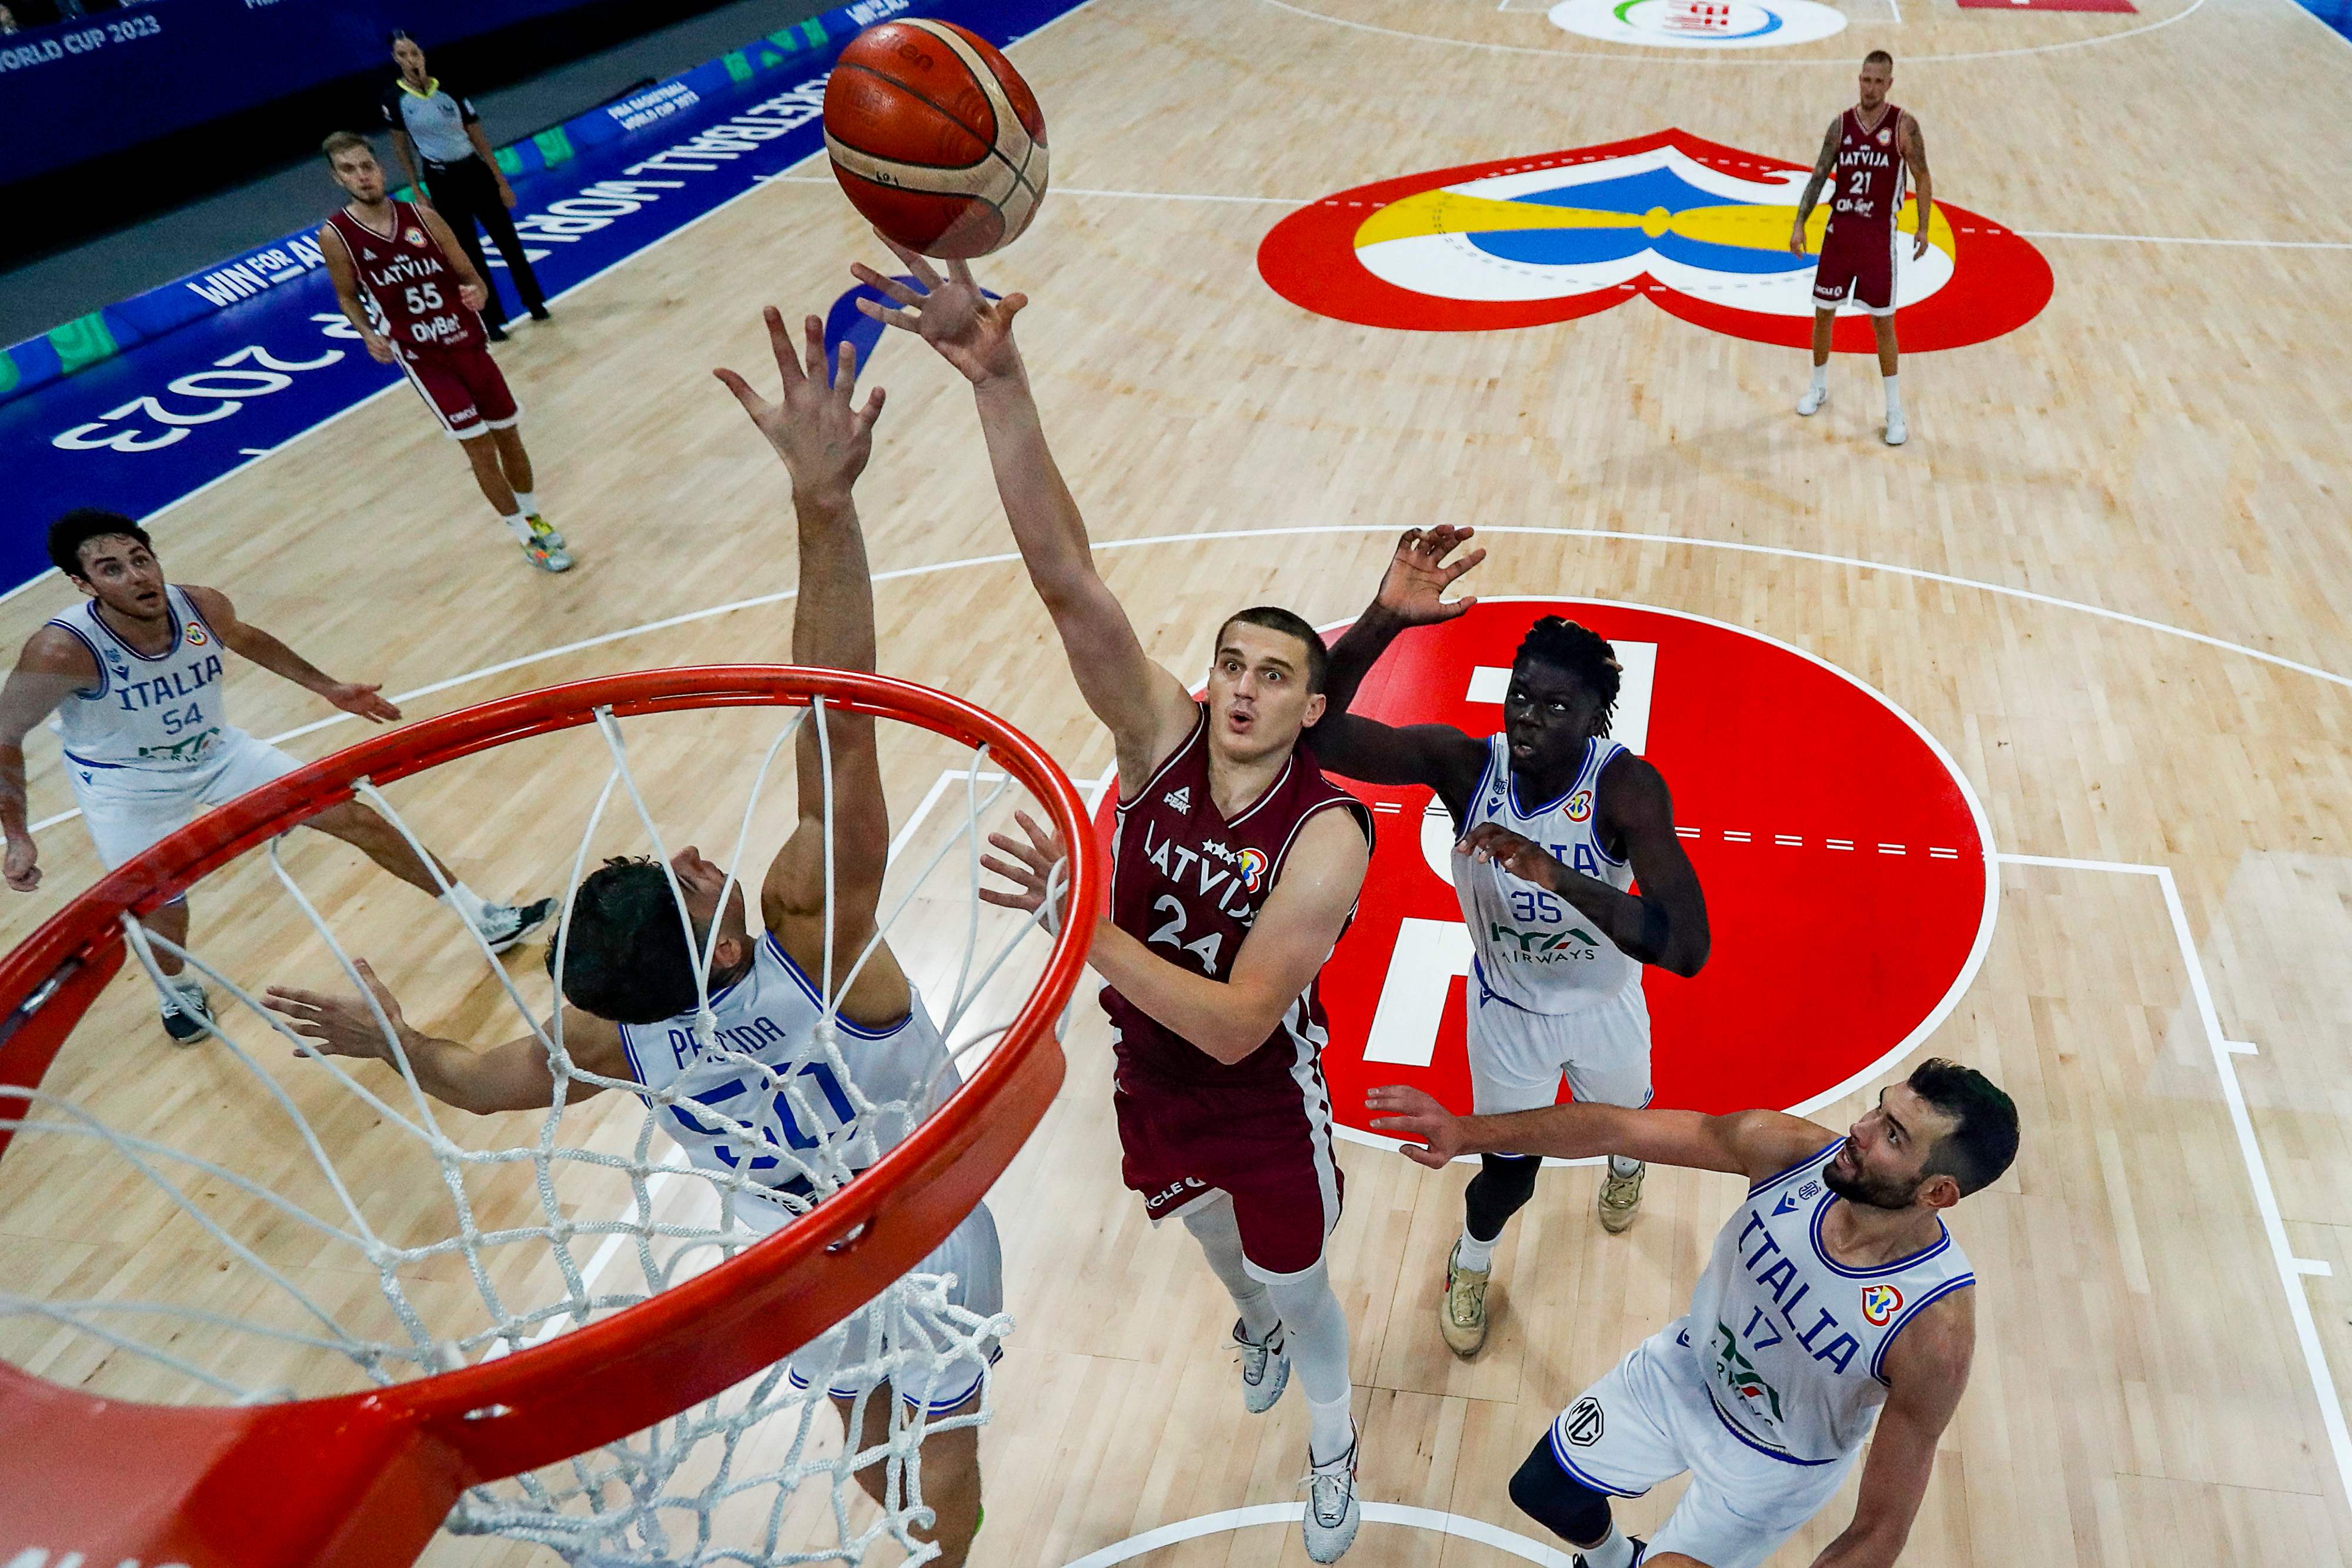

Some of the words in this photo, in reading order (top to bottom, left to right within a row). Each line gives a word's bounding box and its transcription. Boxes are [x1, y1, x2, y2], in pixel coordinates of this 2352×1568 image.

[0, 39, 64, 72] ORLD
[62, 28, 106, 54] CUP
[106, 15, 161, 44] 2023
[1840, 152, 1889, 168] LATVIJA
[1849, 170, 1872, 195] 21
[186, 263, 269, 307] WIN
[246, 248, 295, 275] FOR
[286, 229, 326, 269] AL
[369, 257, 443, 286] LATVIJA
[404, 282, 443, 315] 55
[52, 345, 346, 453] 2023
[115, 654, 223, 711] ITALIA
[162, 702, 203, 735] 54
[1163, 793, 1191, 815] PEAK
[1144, 820, 1258, 928] LATVI
[1511, 891, 1562, 924] 35
[668, 1017, 786, 1070] PCIDA
[1743, 1305, 1783, 1352] 17
[1568, 1401, 1599, 1442] MG
